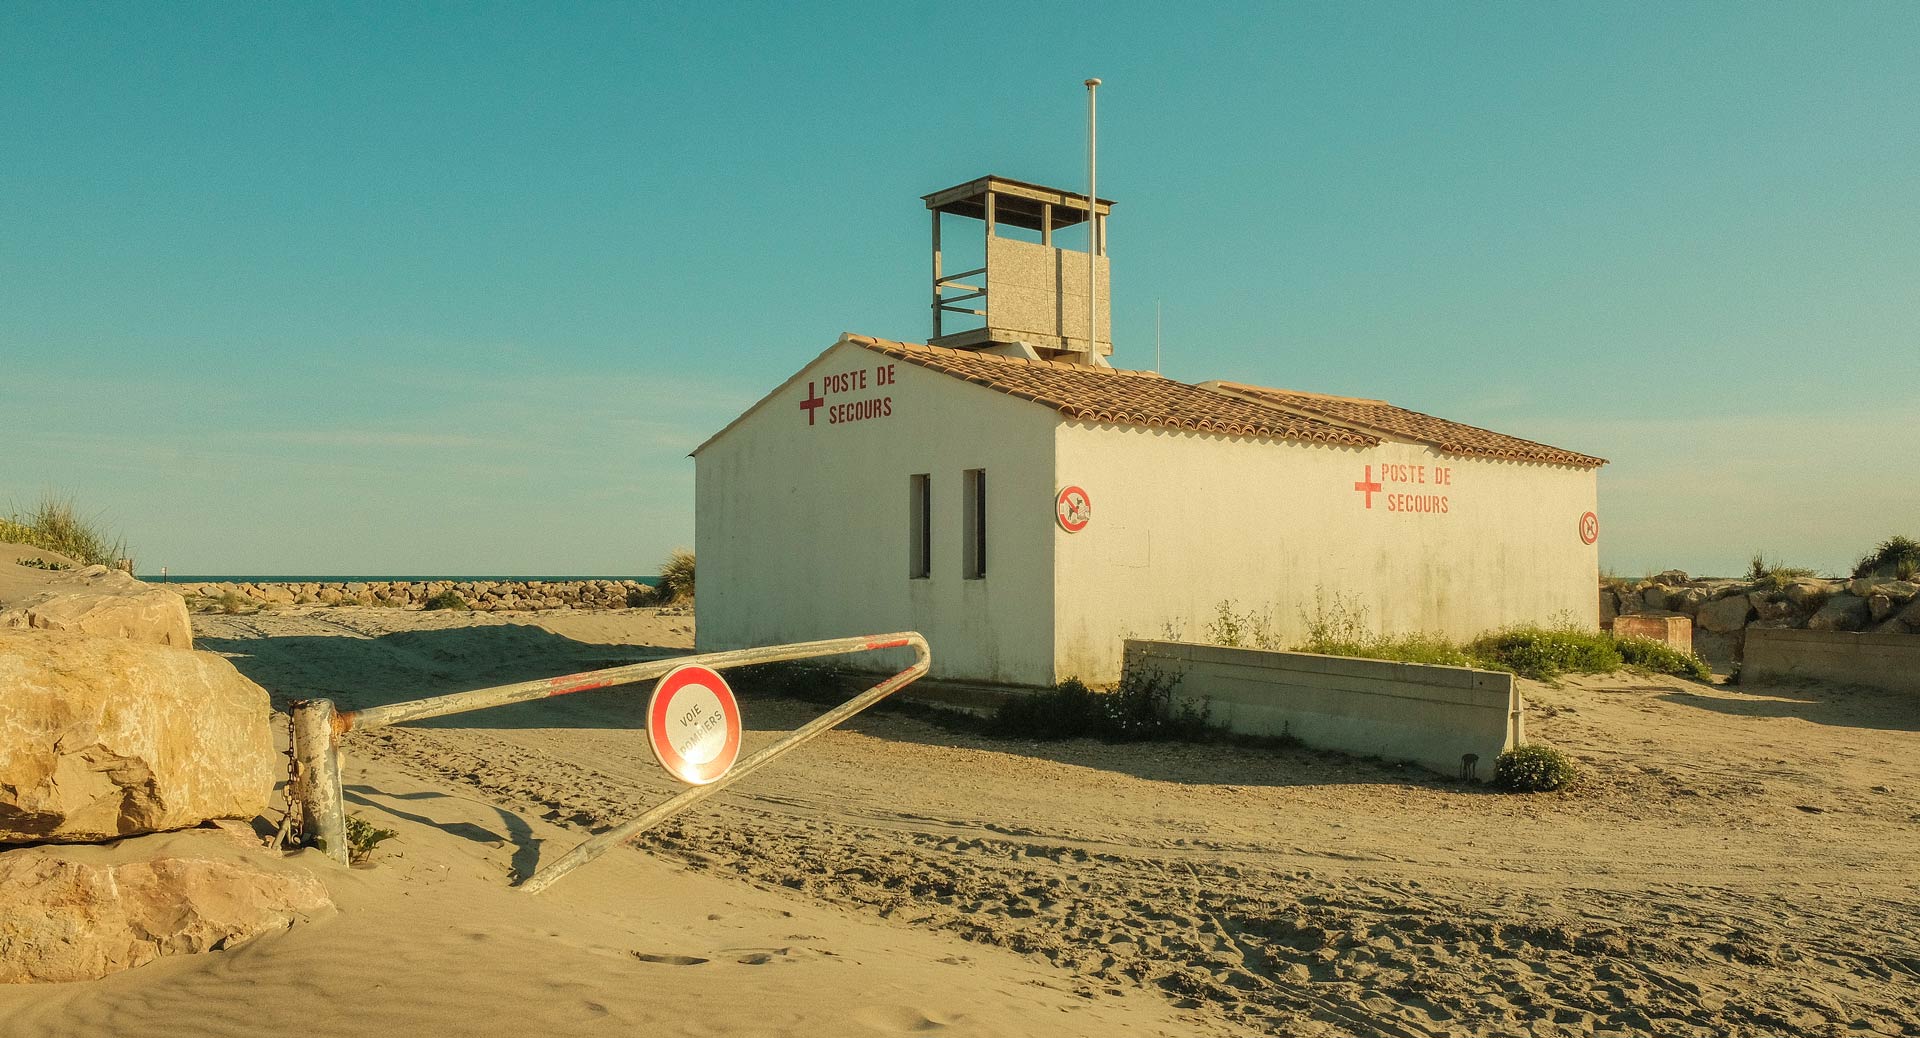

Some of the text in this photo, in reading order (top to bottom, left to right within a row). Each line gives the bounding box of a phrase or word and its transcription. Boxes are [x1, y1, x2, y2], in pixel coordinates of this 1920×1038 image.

[823, 364, 895, 395] POSTE DE
[829, 397, 892, 424] SECOURS
[1381, 463, 1451, 485] POSTE DE
[1388, 493, 1449, 513] SECOURS
[680, 704, 702, 728] VOIE
